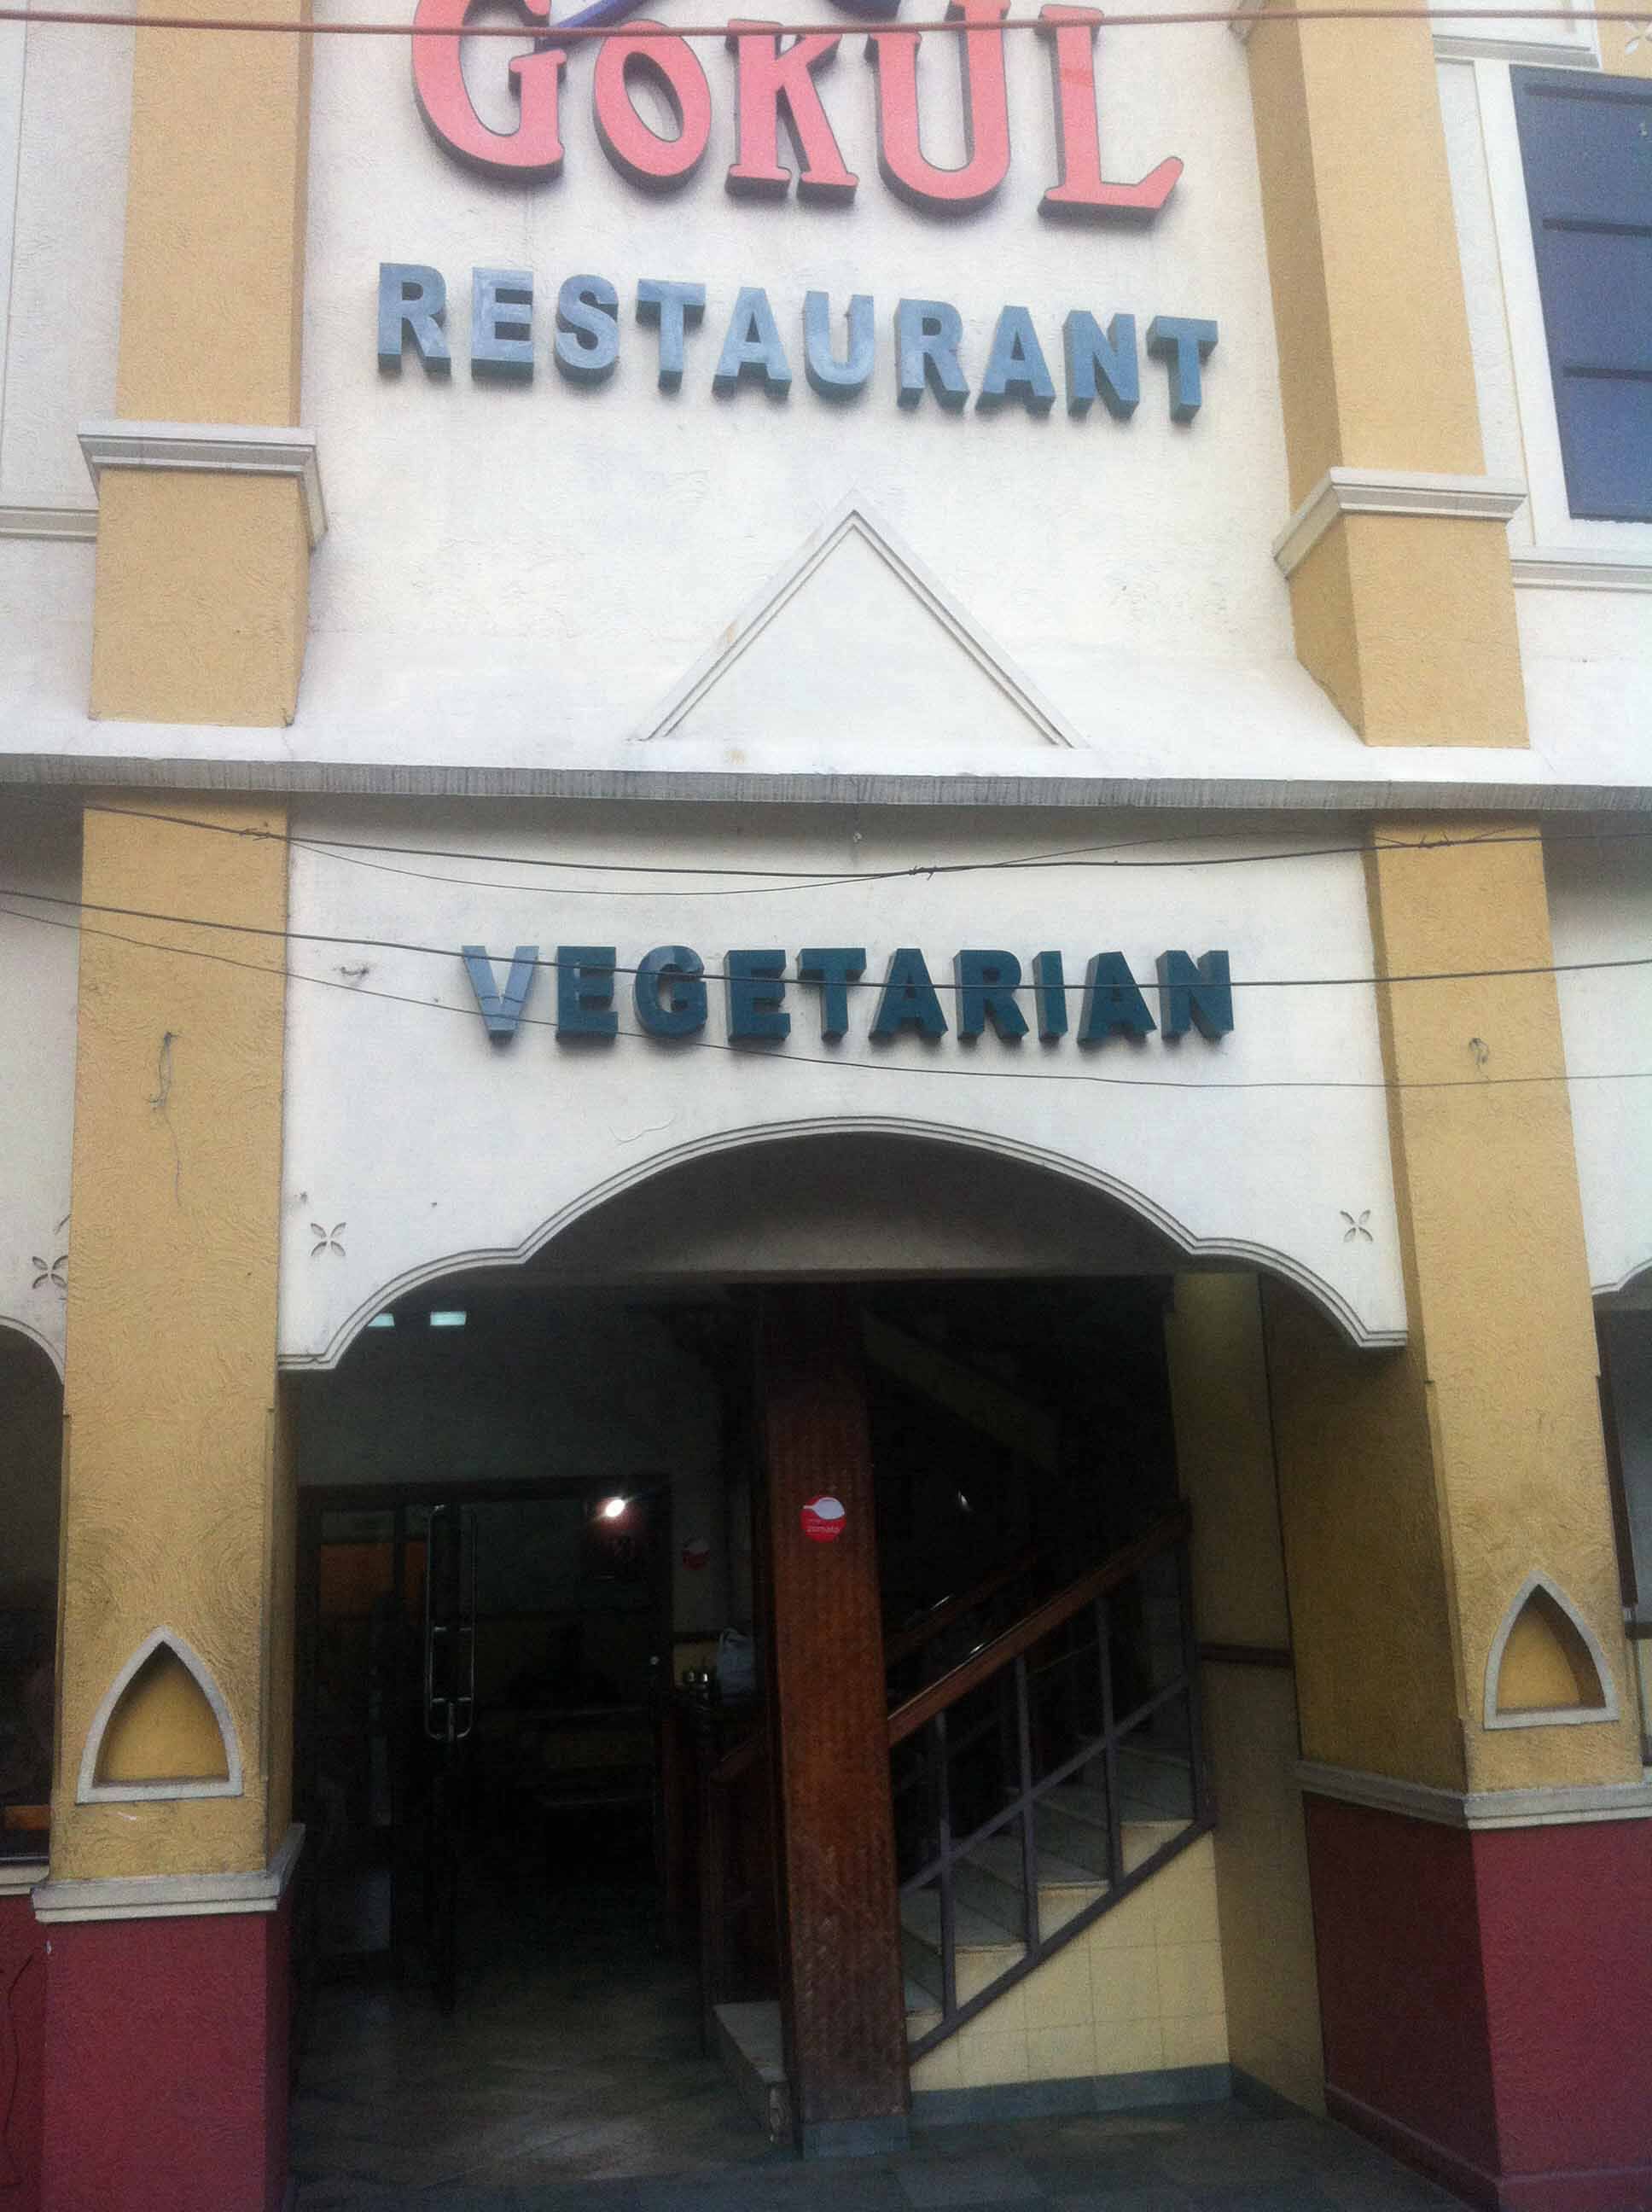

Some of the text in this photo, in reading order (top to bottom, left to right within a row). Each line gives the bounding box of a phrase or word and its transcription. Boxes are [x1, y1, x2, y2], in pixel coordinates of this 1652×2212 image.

[411, 0, 1184, 228] GOKUL
[378, 261, 1219, 422] RESTAURANT
[461, 945, 1235, 1045] VEGETARIAN
